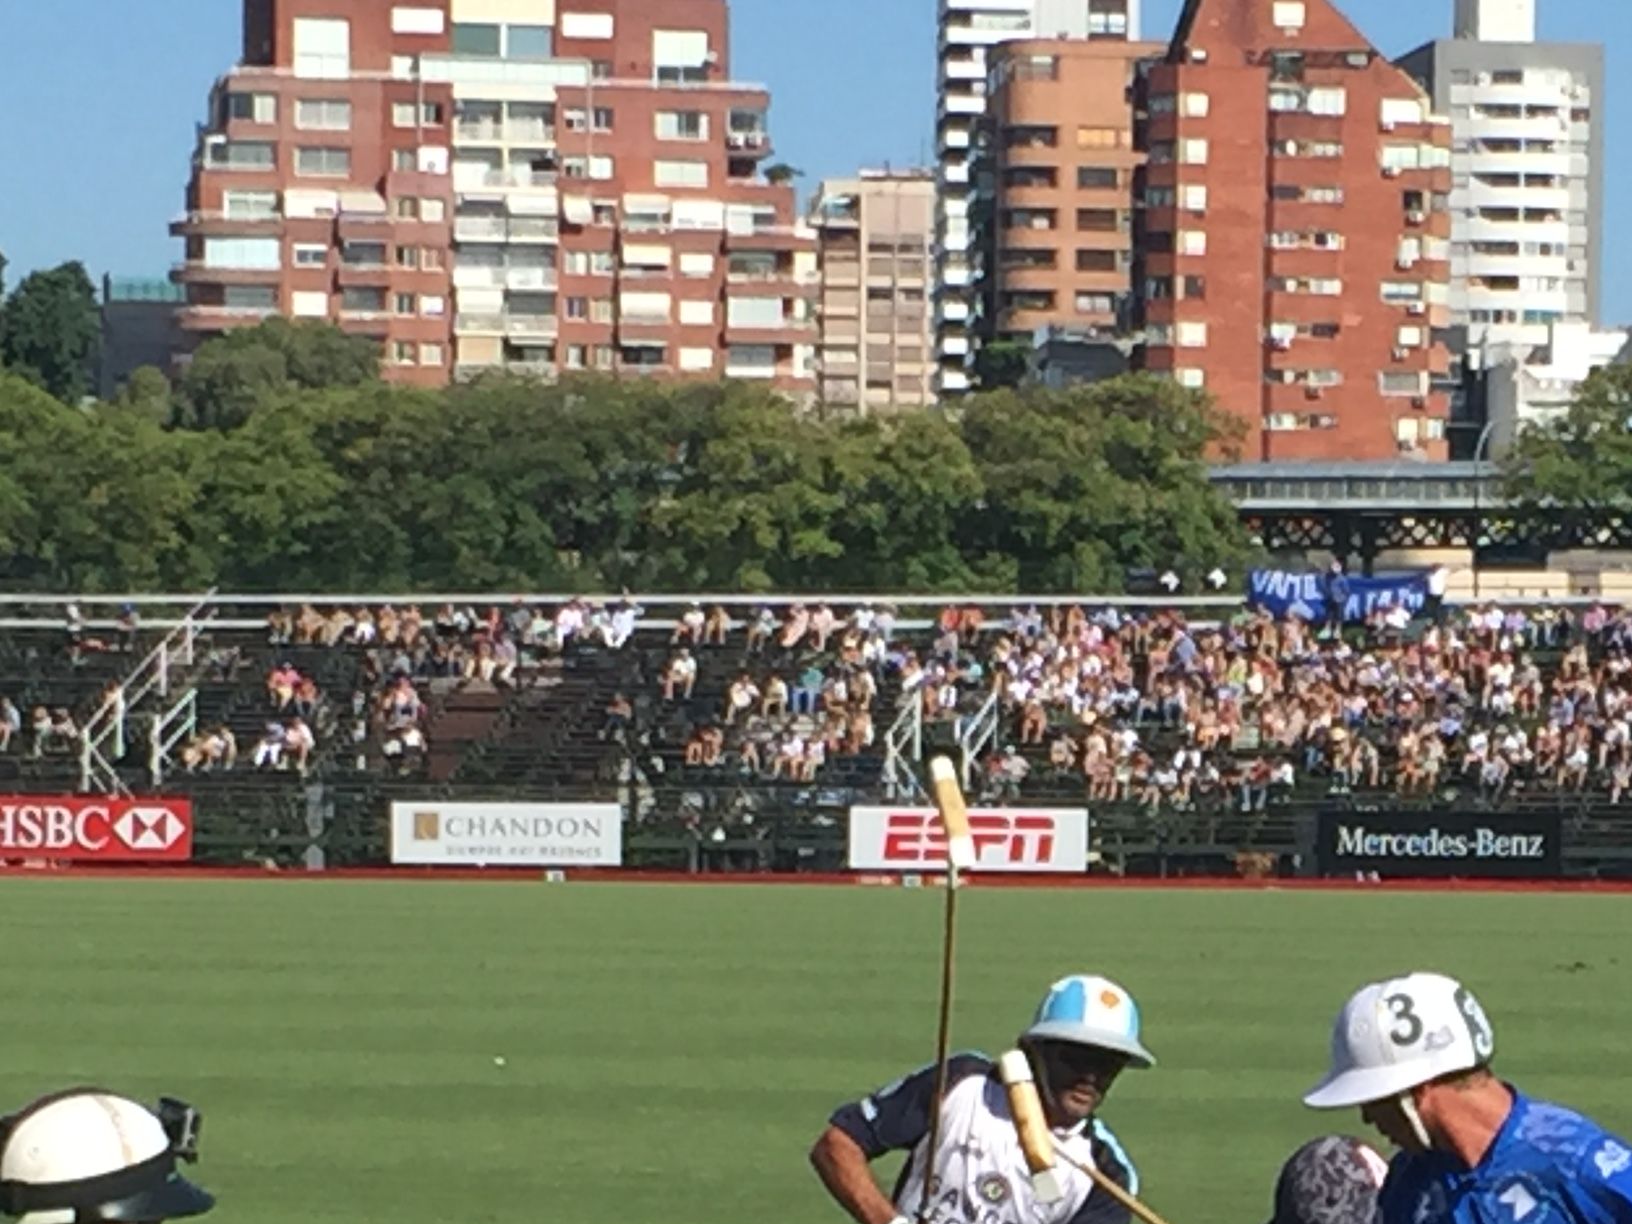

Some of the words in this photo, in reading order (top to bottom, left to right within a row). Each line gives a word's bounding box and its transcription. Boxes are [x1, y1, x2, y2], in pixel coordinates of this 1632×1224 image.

[445, 816, 602, 838] CHANDON
[1336, 825, 1544, 857] Mercedes-Benz
[1386, 993, 1423, 1046] 3
